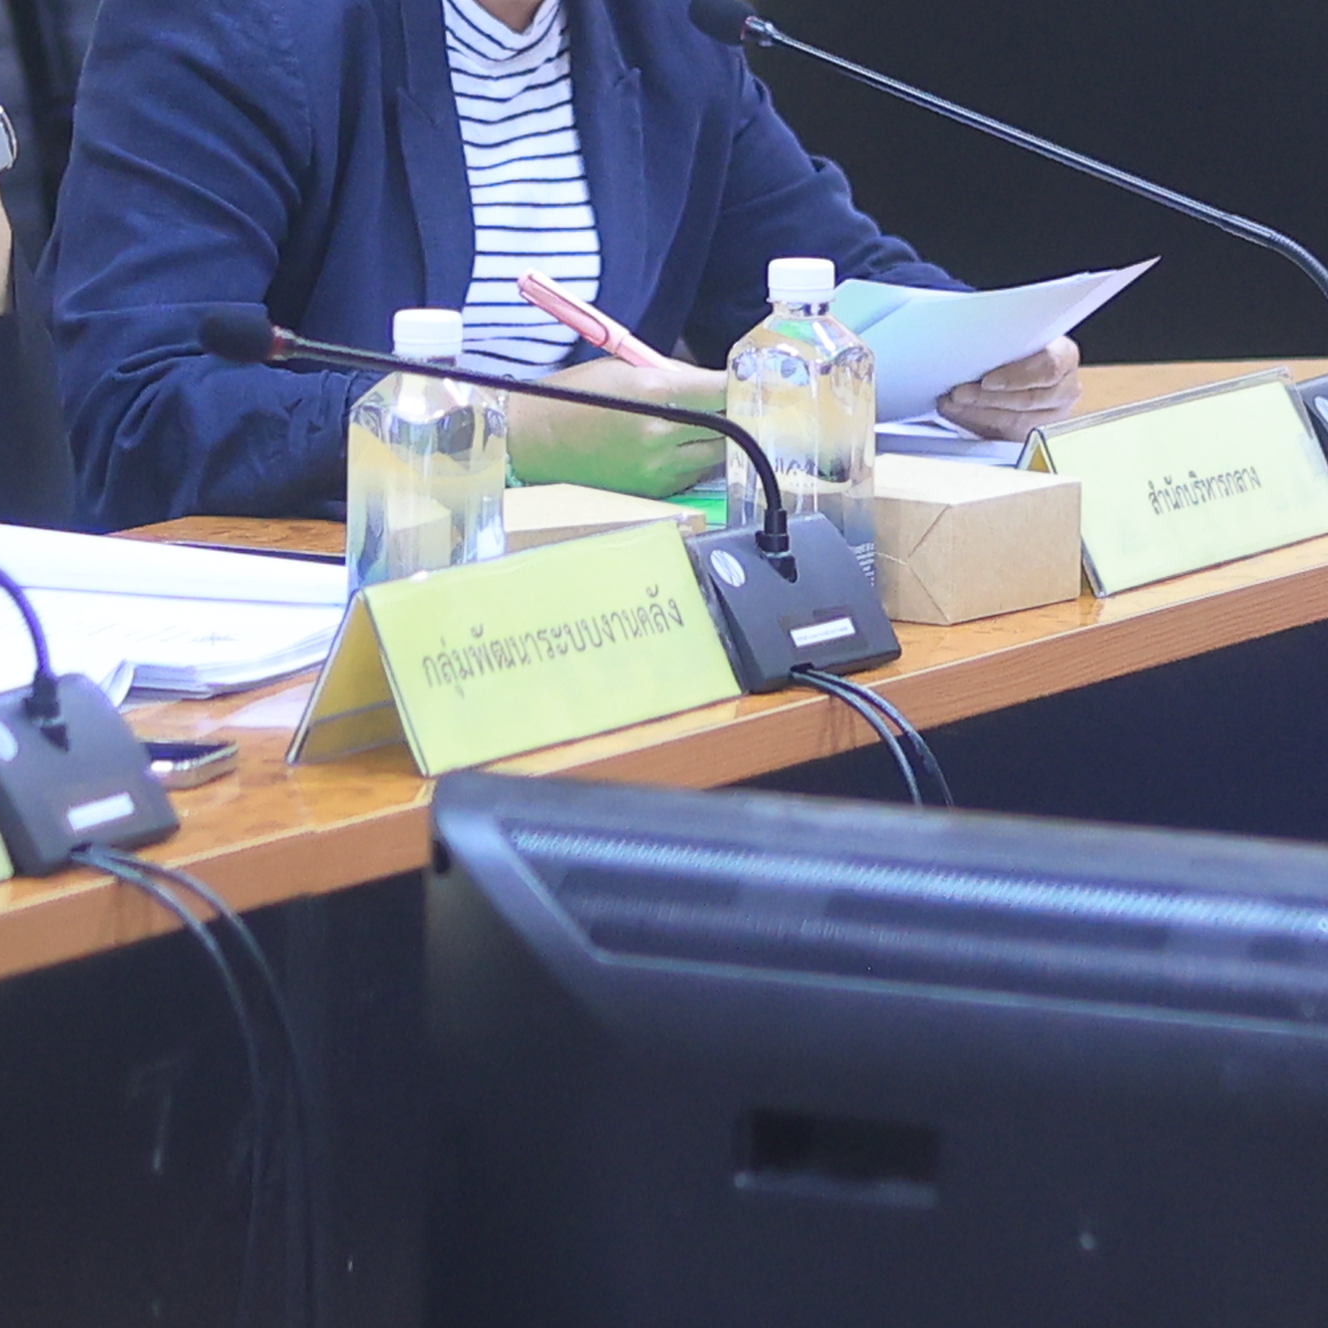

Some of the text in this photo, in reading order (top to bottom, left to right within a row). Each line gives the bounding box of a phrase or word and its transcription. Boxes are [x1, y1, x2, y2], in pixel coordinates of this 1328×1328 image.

[1147, 465, 1262, 516] สำนักบริหารกลาง
[421, 584, 685, 698] กลุ่มพัฒนาระบบงานคลัง
